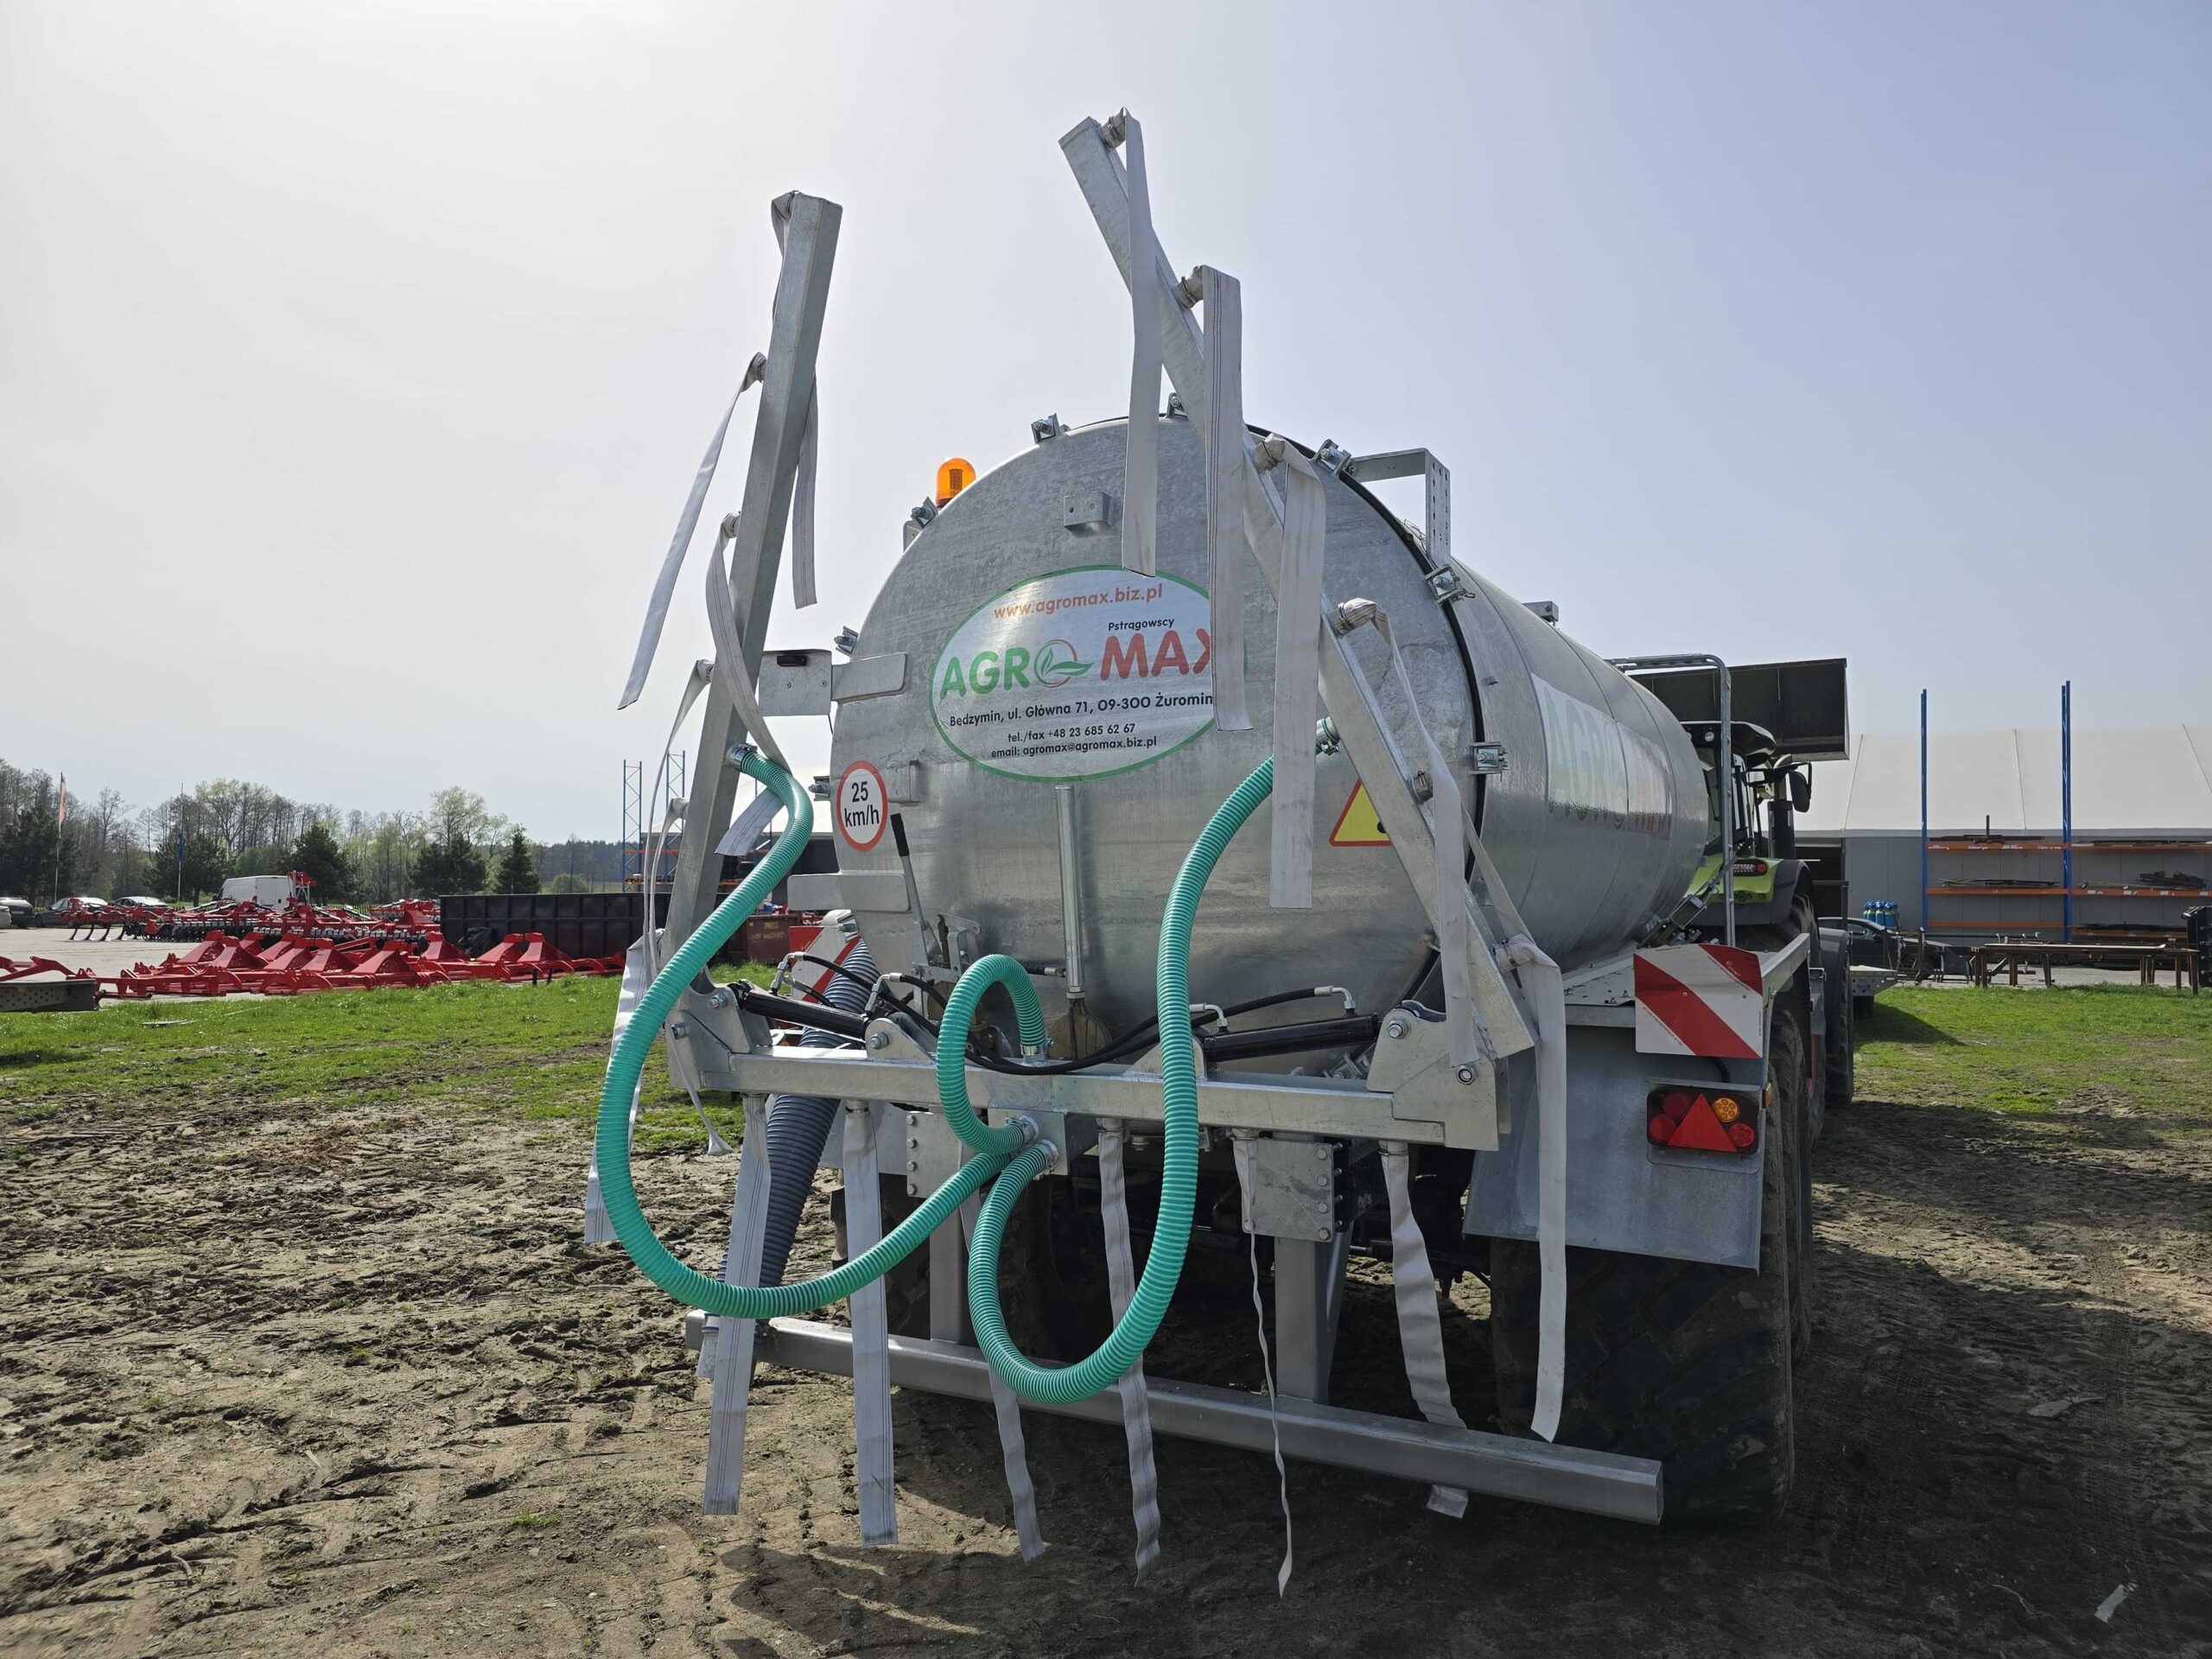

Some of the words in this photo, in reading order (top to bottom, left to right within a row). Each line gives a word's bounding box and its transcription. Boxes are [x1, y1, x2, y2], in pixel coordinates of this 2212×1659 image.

[994, 583, 1162, 620] www.agromax.biz.pl
[1108, 617, 1175, 632] Pstrągowscy
[950, 710, 1004, 728] Będzymin,
[1007, 708, 1021, 720] ul.
[1026, 704, 1071, 718] Główna
[1075, 701, 1094, 714] 71,
[1097, 696, 1151, 711] 09-300
[1007, 730, 1045, 743] tel./fax
[1047, 728, 1065, 739] +48
[1069, 727, 1081, 737] 23
[1084, 725, 1103, 736] 685
[1107, 724, 1120, 734] 62
[1123, 723, 1136, 734] 67
[991, 749, 1020, 759] email:
[1022, 735, 1157, 757] agromax@agromax.biz.pl
[851, 780, 869, 803] 25
[844, 804, 880, 828] km/h
